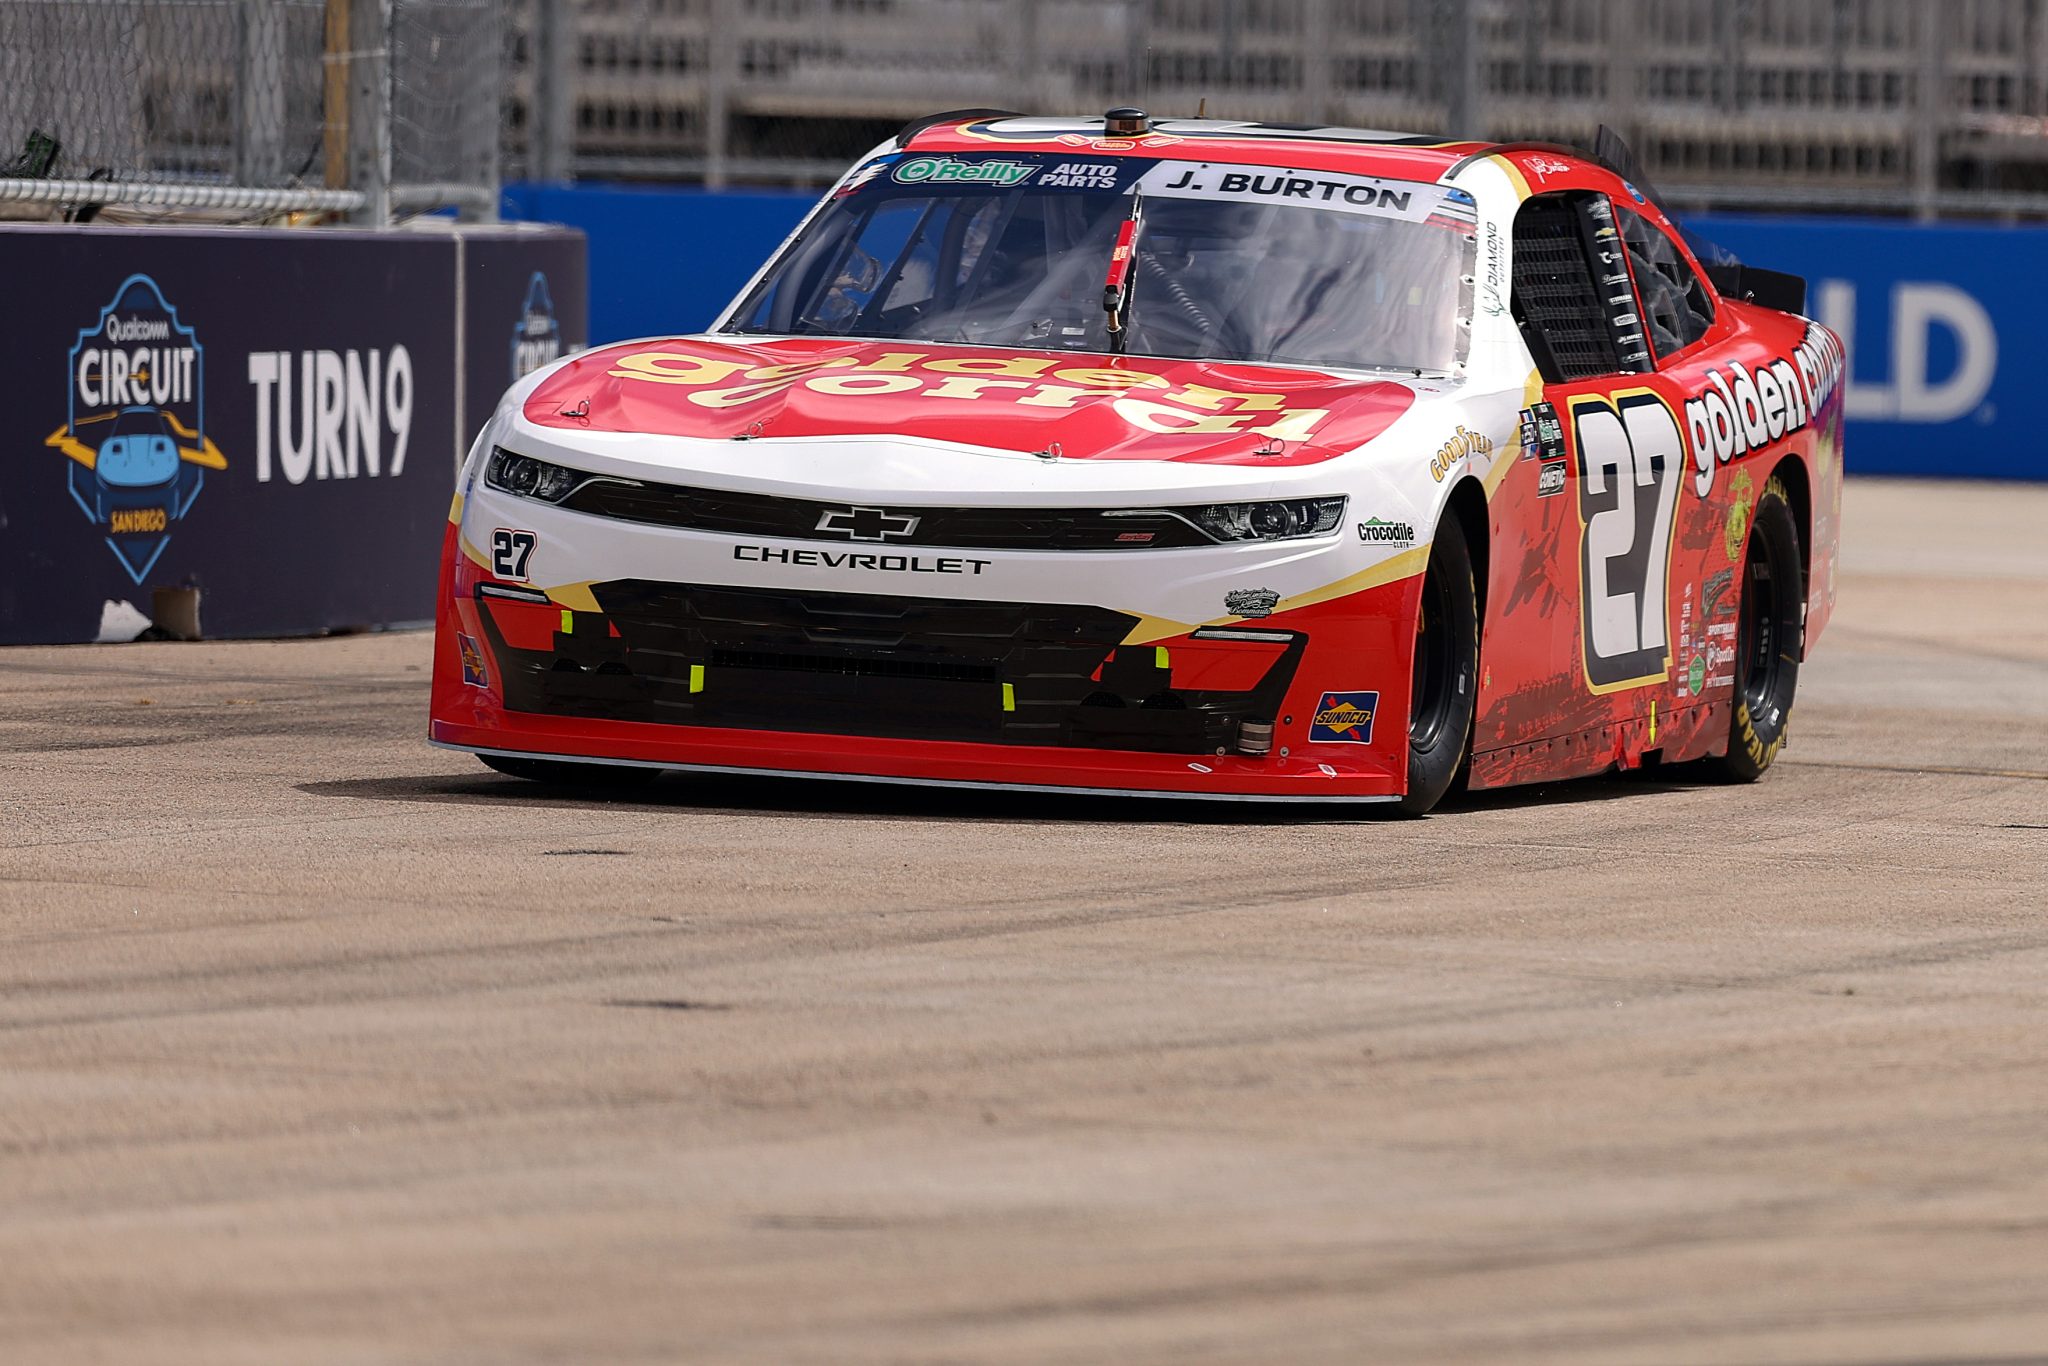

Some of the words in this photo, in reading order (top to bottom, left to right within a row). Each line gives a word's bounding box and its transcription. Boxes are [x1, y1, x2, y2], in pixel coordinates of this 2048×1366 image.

[897, 157, 1037, 186] O'Reilly
[1037, 174, 1118, 189] PARTS
[1051, 162, 1117, 177] AUTO
[1165, 170, 1203, 191] J.
[1218, 173, 1412, 212] BURTON
[1487, 220, 1499, 287] DIAMOND
[106, 313, 170, 345] Qualcomm
[78, 346, 196, 407] CIRCUIT
[249, 348, 381, 485] TURN
[386, 343, 414, 478] 9
[1684, 358, 1808, 499] golden
[1430, 427, 1494, 483] GOODYEAR
[111, 510, 134, 533] SAN
[134, 508, 167, 532] DIEGO
[1357, 522, 1415, 541] Crocodile
[1574, 398, 1685, 665] 27
[493, 530, 536, 578] 27
[733, 545, 992, 575] CHEVROLET
[1393, 541, 1410, 549] CLOTH
[1316, 711, 1369, 724] SUNOCO
